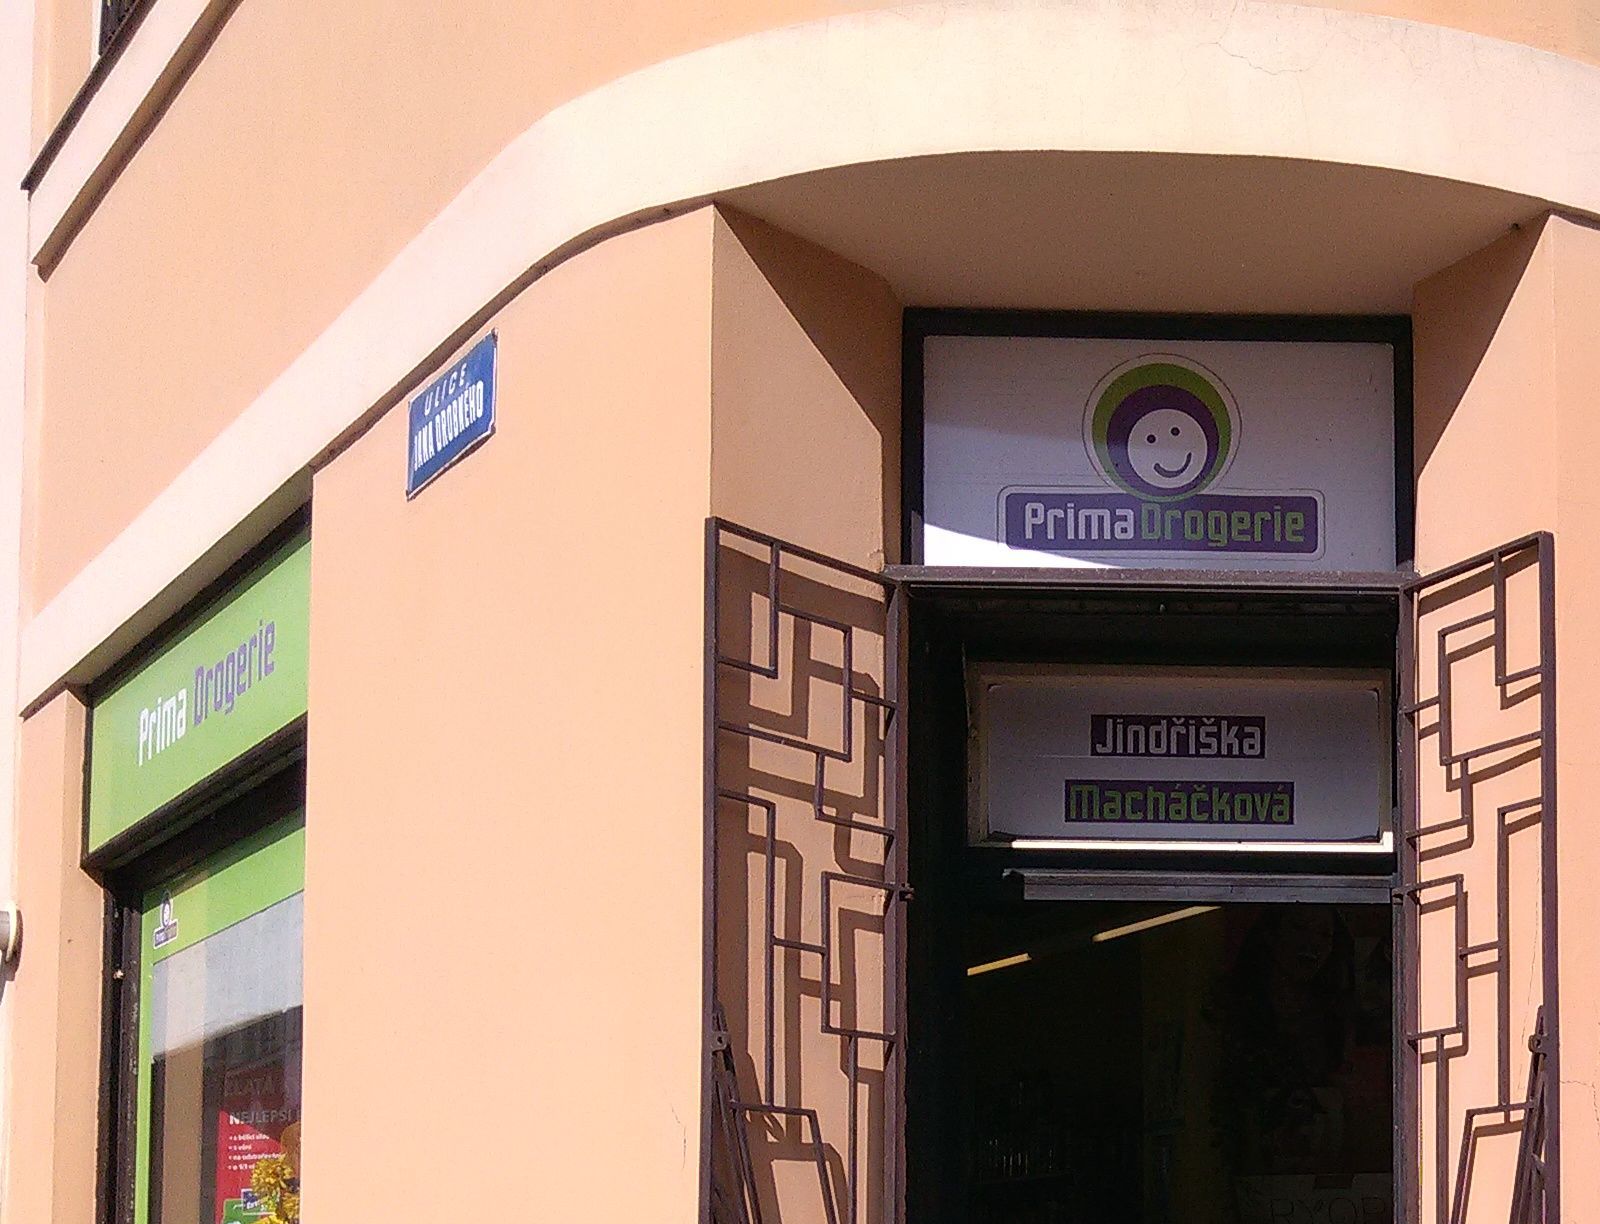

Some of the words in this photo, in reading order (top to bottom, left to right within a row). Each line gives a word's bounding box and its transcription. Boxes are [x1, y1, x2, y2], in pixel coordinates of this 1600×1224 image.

[424, 362, 467, 416] ULICE
[414, 420, 435, 472] JANA
[434, 381, 484, 452] DROBNÉHO
[1024, 502, 1135, 541] Prima
[1140, 504, 1306, 547] Drogerie
[137, 687, 188, 768] Prima
[193, 618, 277, 727] Drogerie
[1095, 716, 1263, 757] Jindřiška
[1068, 783, 1292, 823] Macháčková
